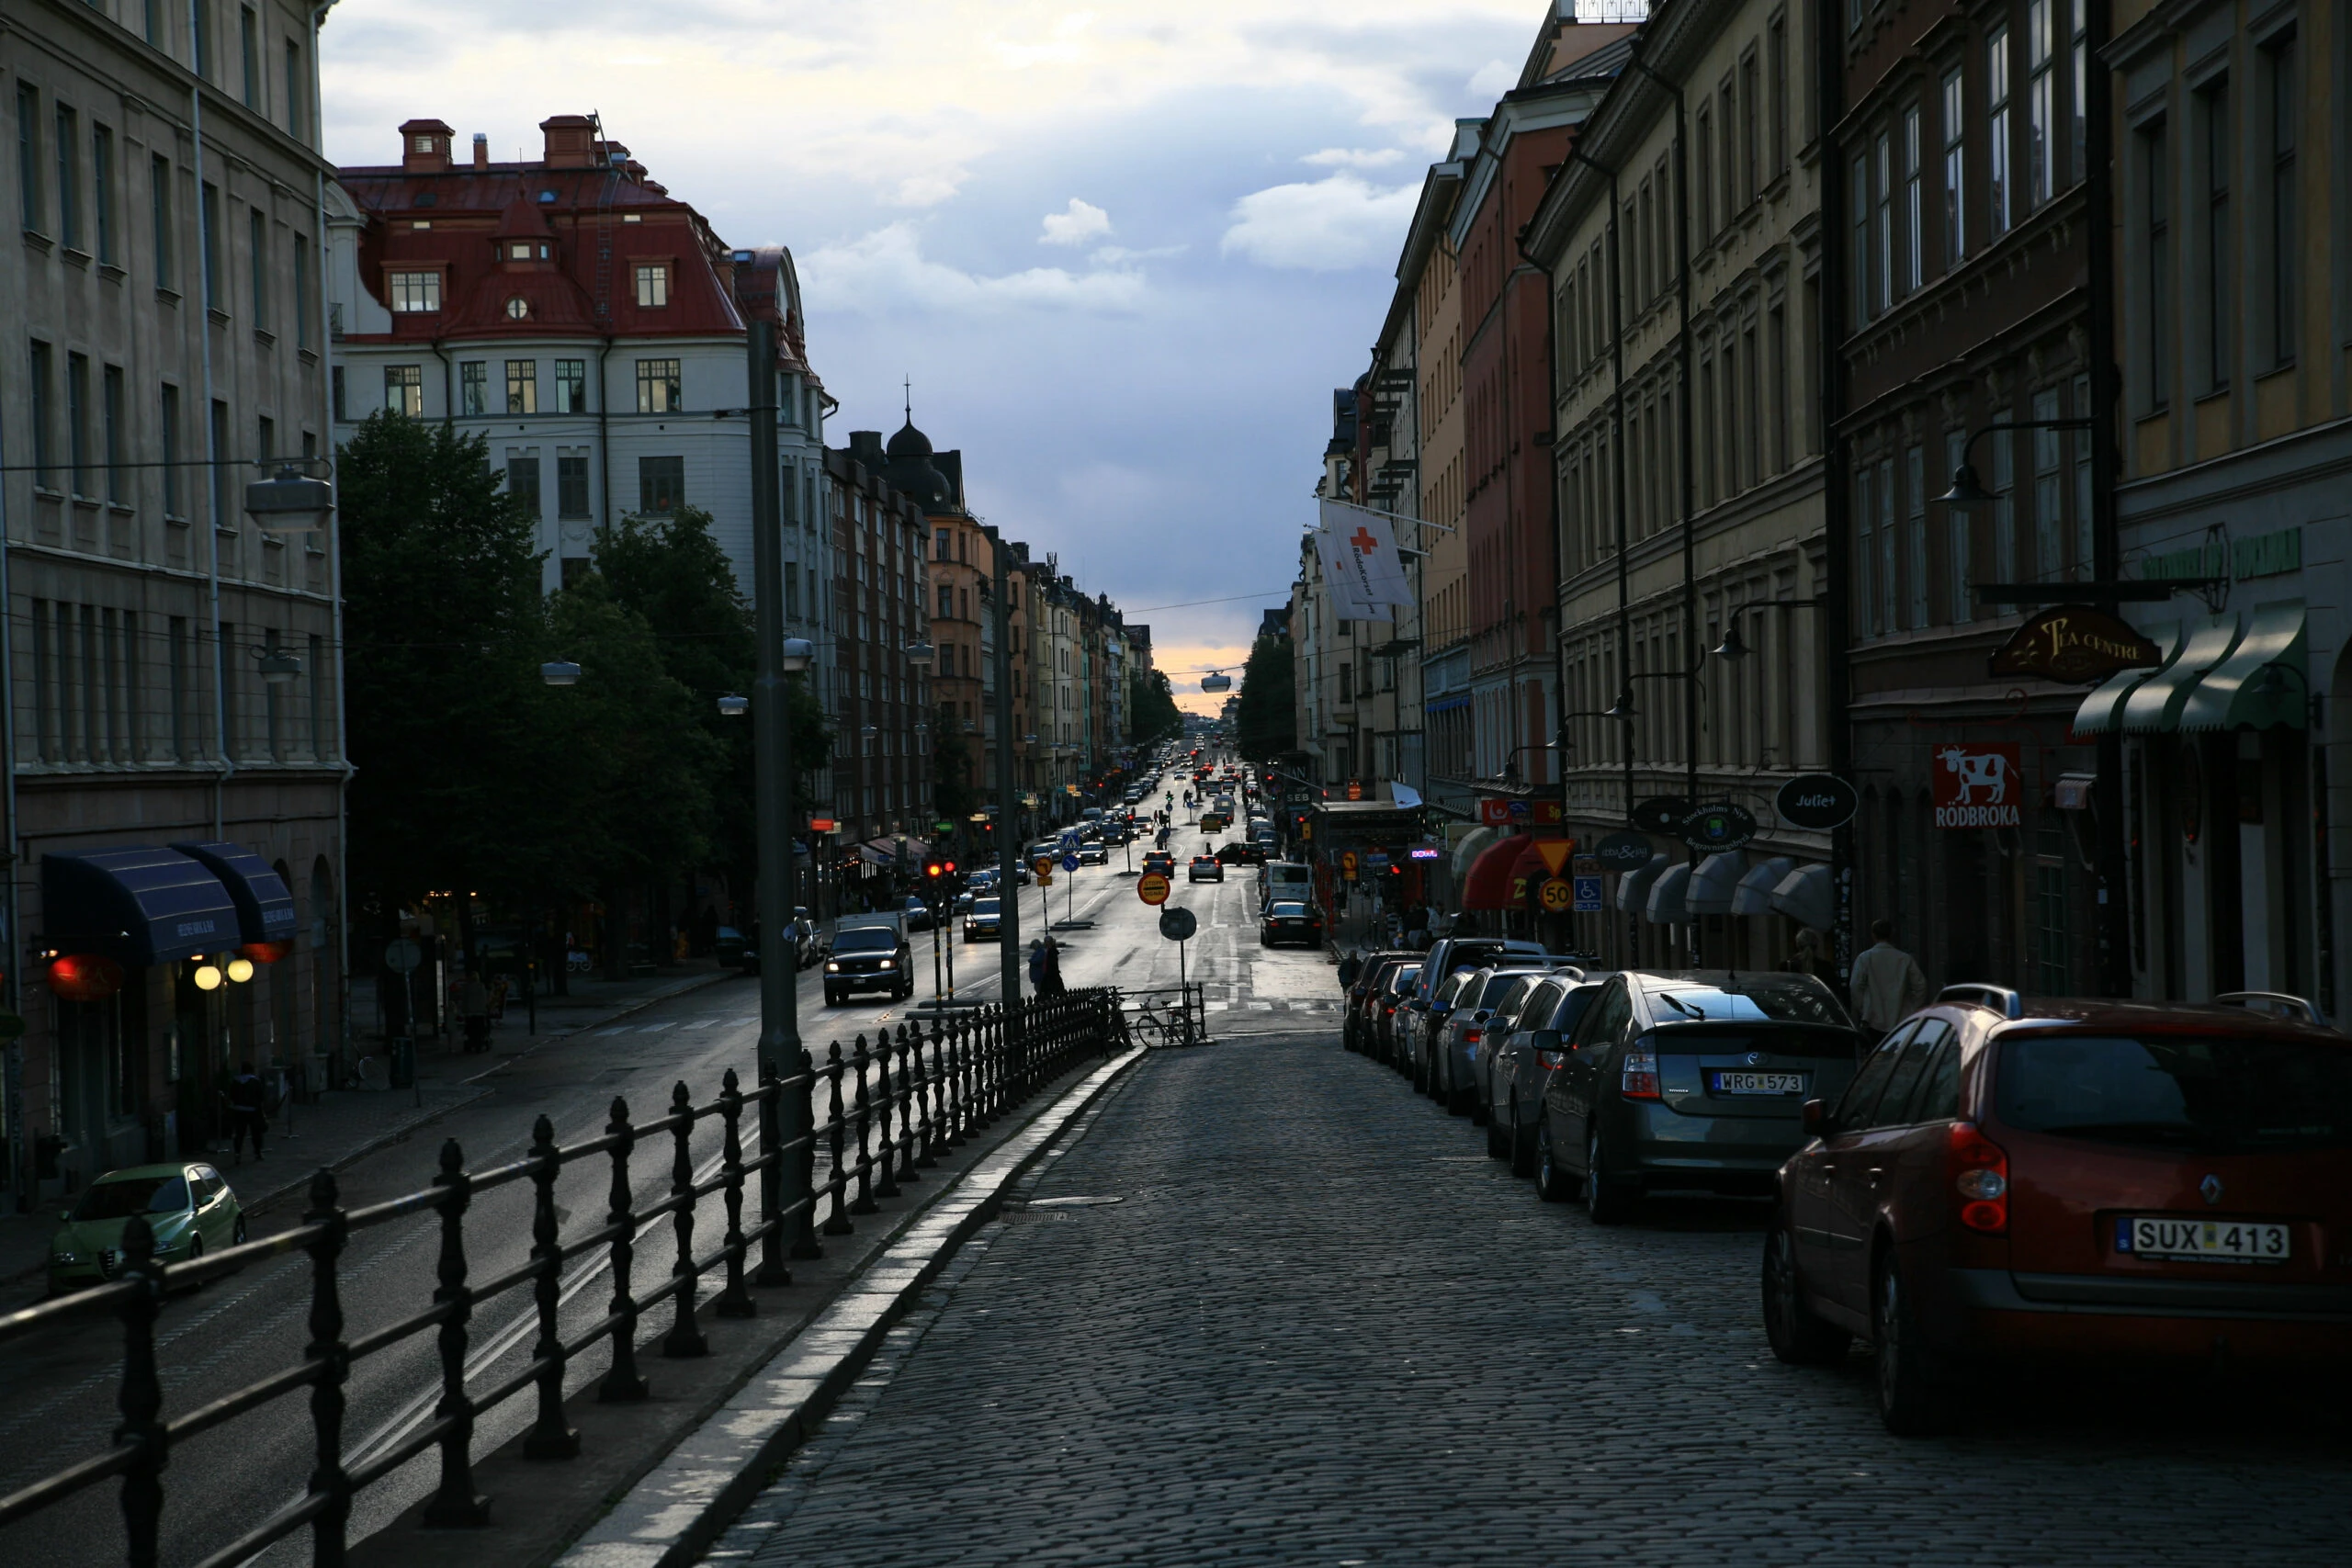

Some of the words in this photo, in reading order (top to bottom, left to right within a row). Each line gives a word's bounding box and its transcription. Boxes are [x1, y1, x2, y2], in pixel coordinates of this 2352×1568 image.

[2084, 634, 2141, 660] CENTRE
[1286, 793, 1309, 802] SEB
[1794, 793, 1838, 808] Juliet
[1682, 804, 1728, 826] Stockholms
[1734, 807, 1748, 821] Nya
[1936, 801, 2020, 828] RÖDBROKA
[1545, 886, 1569, 904] 50
[1723, 1075, 1755, 1089] WRG
[1768, 1076, 1799, 1090] 573
[2138, 1222, 2199, 1251] SUX
[2224, 1226, 2283, 1255] 413
